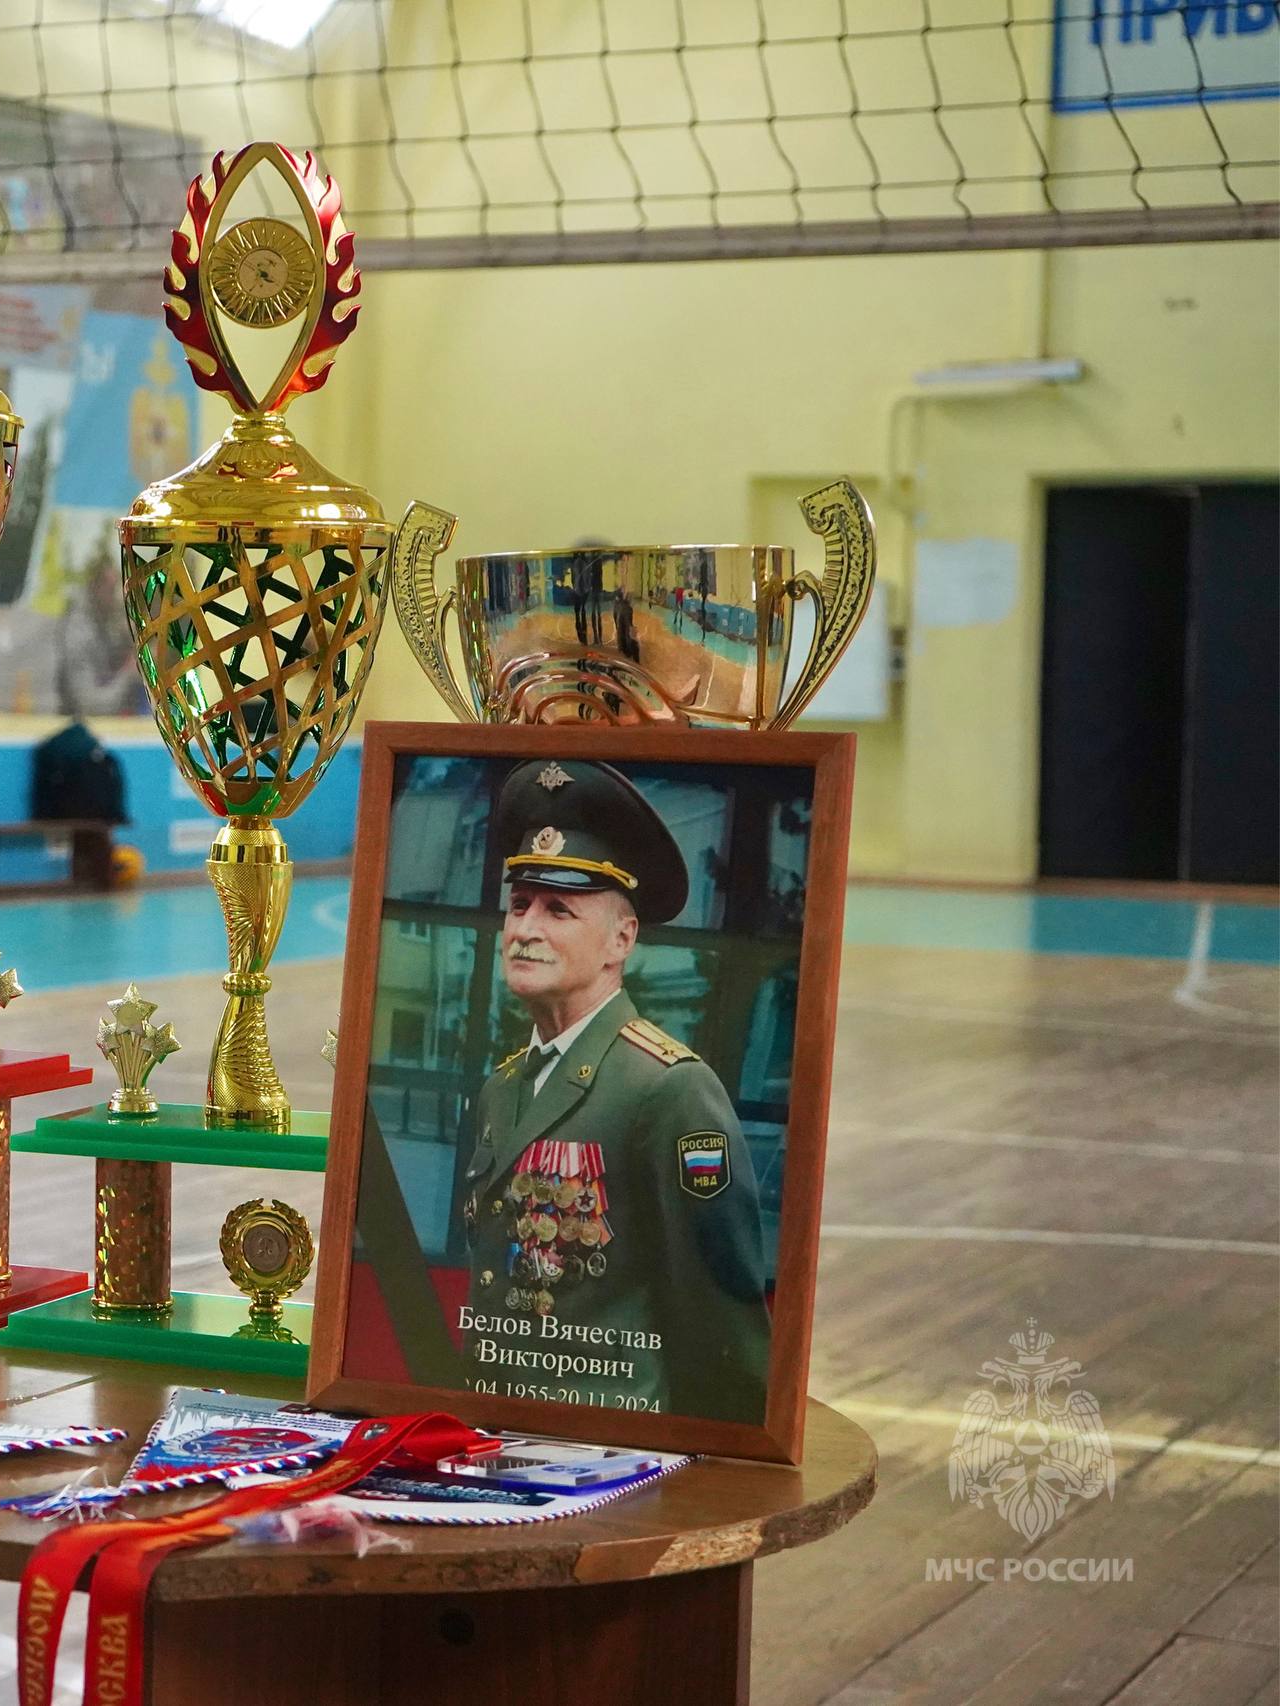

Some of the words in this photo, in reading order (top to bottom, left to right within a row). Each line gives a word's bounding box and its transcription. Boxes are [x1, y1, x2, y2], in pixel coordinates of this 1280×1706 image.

[681, 1137, 724, 1151] РОССИЯ
[457, 1306, 531, 1336] Белов
[540, 1315, 662, 1350] Вячеслав
[478, 1338, 635, 1379] Викторович
